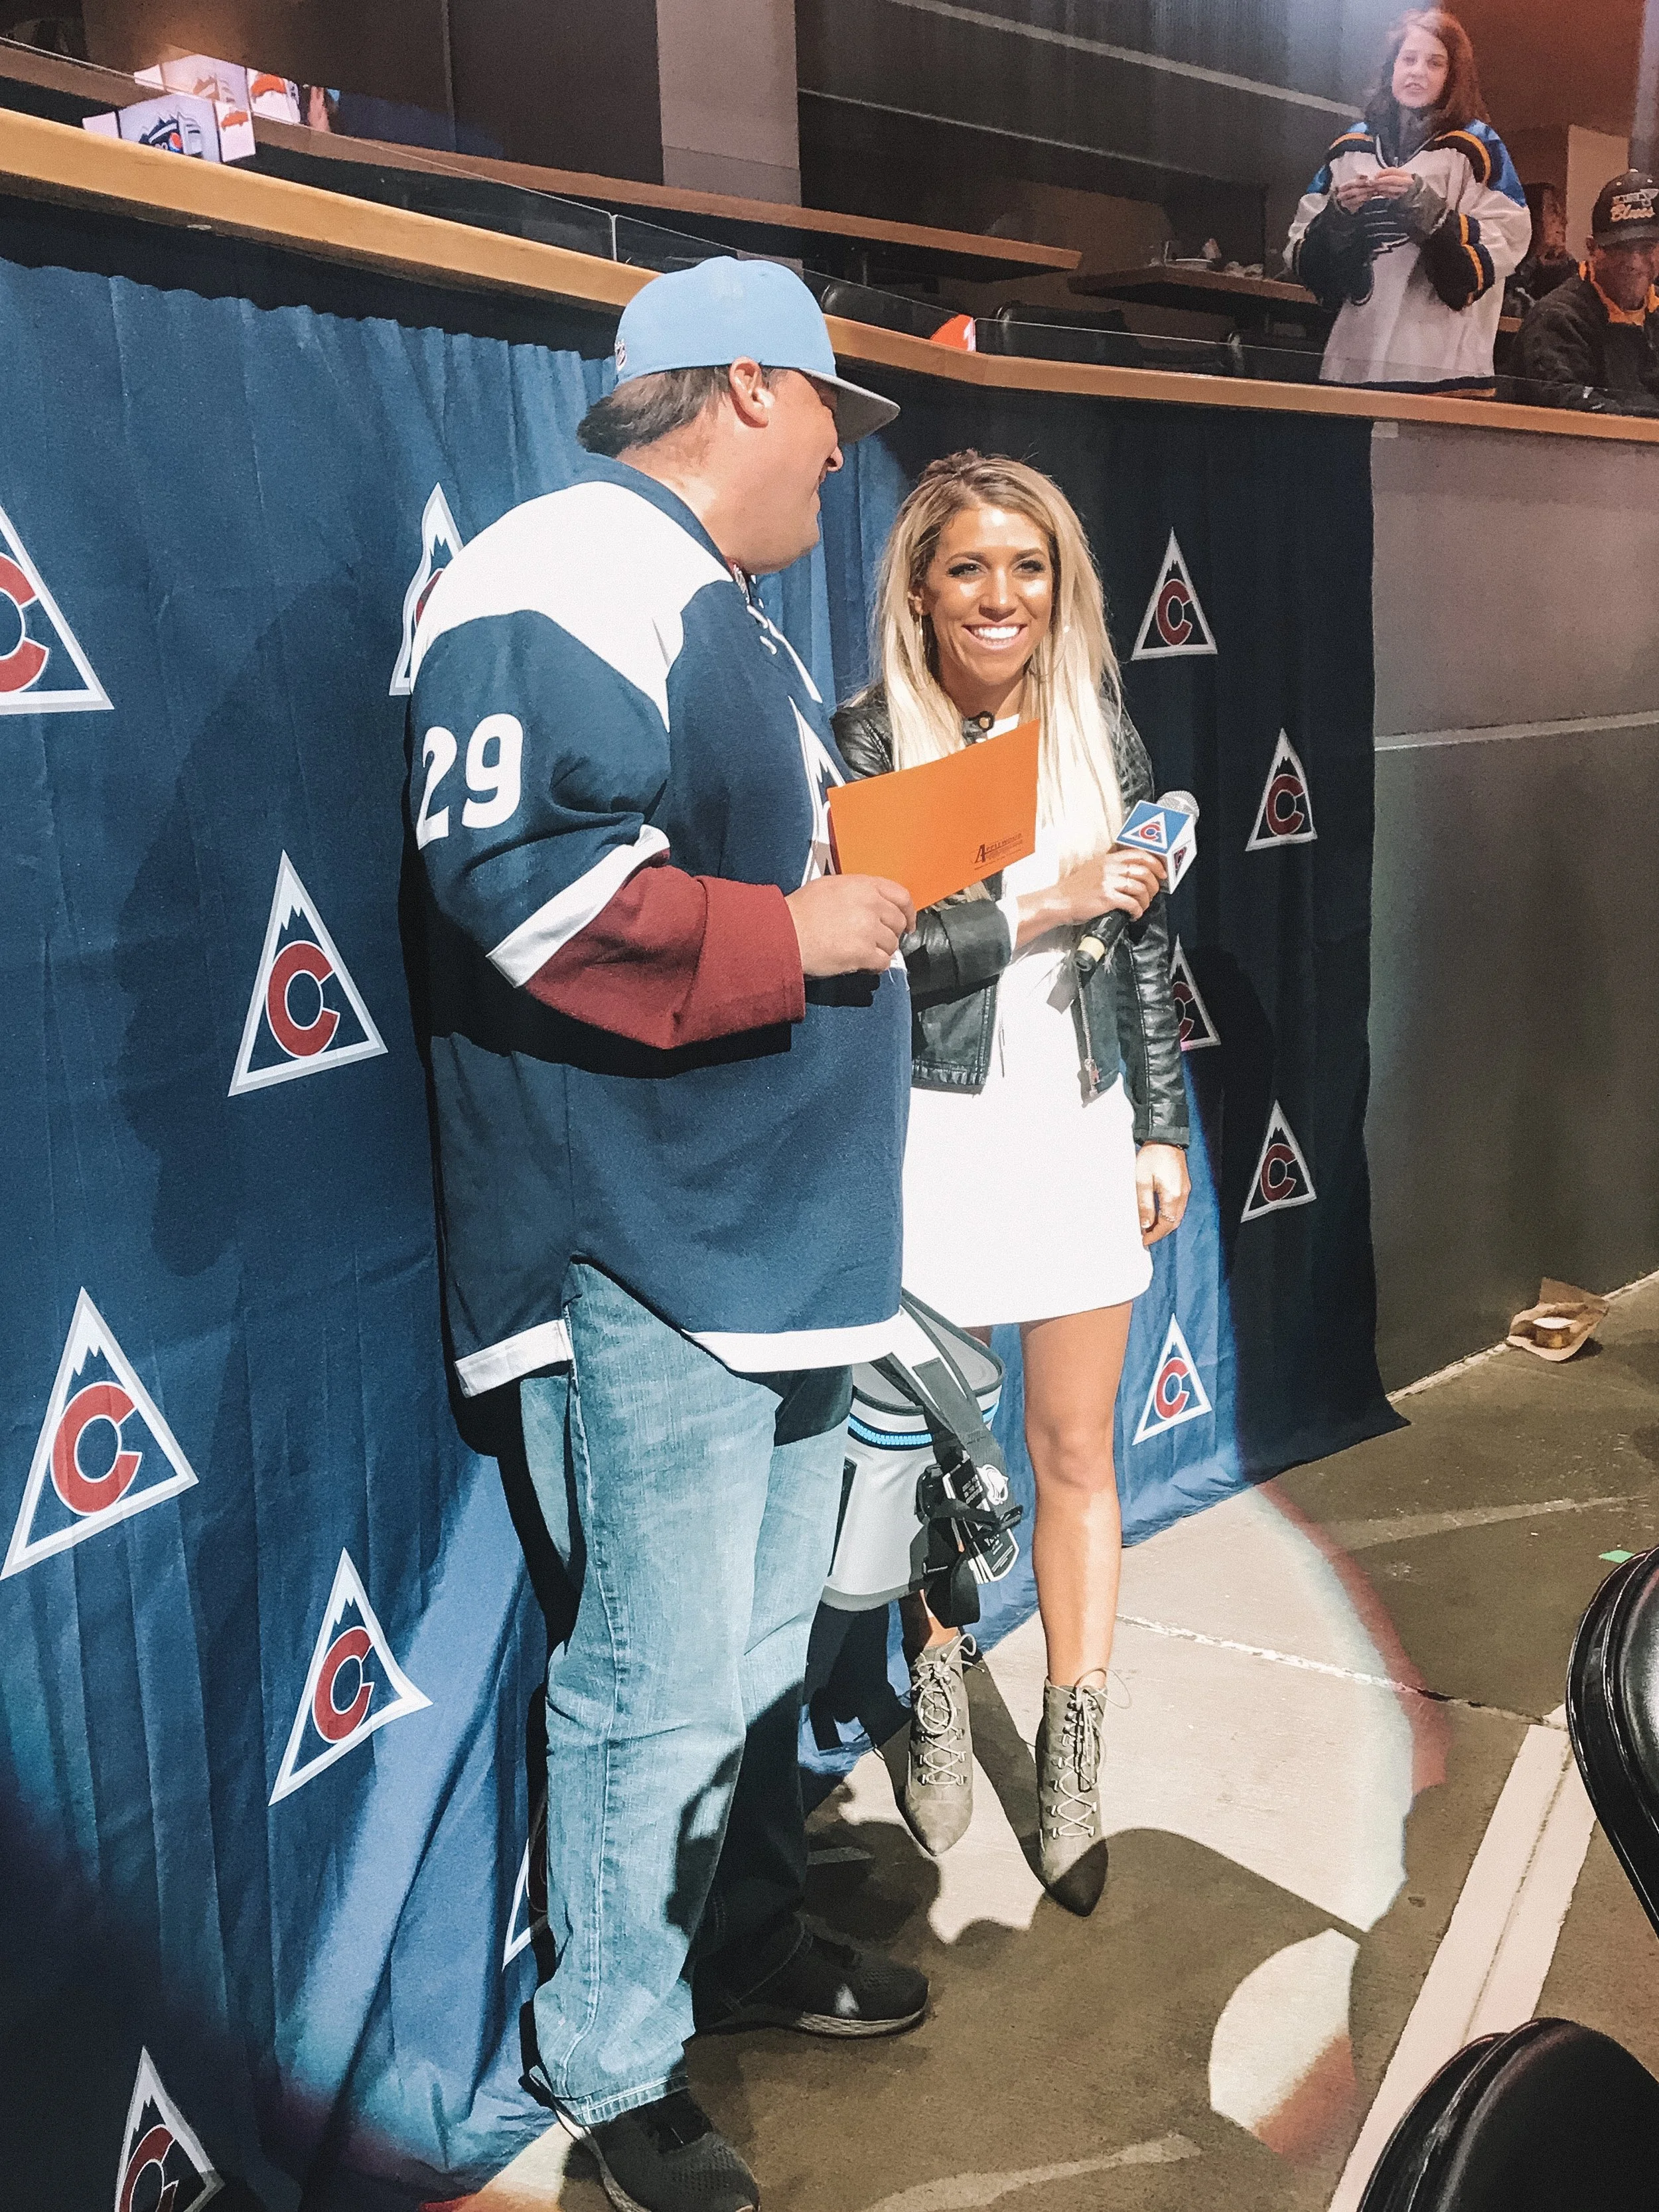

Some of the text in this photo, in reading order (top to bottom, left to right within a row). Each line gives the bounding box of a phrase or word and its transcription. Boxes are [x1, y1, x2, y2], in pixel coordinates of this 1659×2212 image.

[1156, 579, 1192, 646] C
[416, 713, 524, 850] 29
[1266, 773, 1305, 836] C
[1139, 823, 1161, 842] C
[265, 940, 340, 1057] C
[1260, 1143, 1297, 1203] C
[1153, 1357, 1190, 1420] C
[50, 1380, 142, 1516] C
[312, 1625, 374, 1743] C
